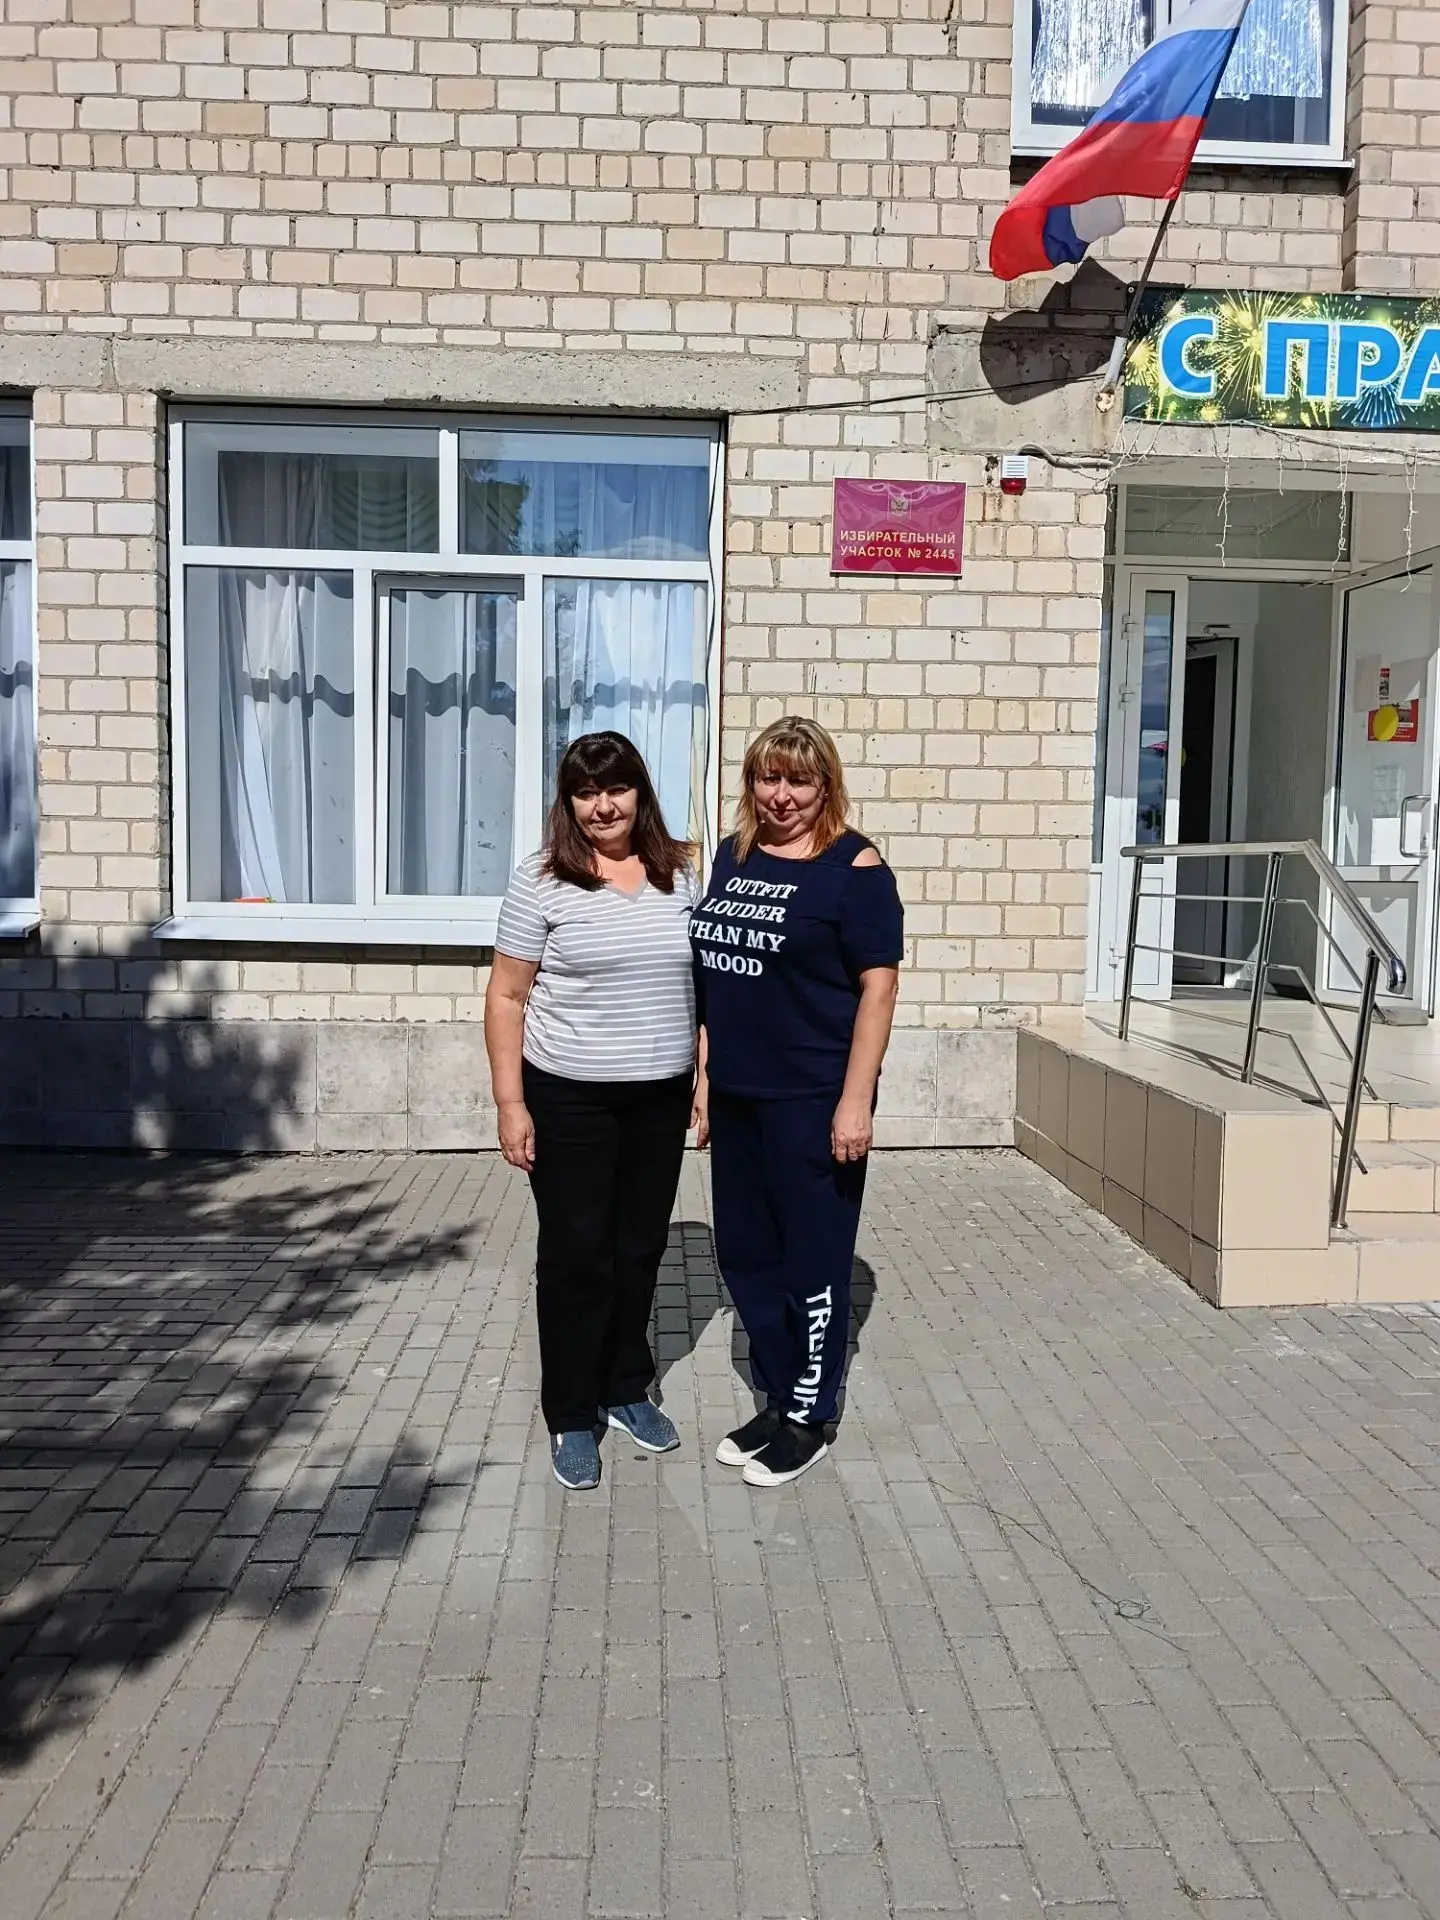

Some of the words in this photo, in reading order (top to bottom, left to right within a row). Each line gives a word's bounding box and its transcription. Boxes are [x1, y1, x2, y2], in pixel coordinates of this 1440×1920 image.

[1160, 315, 1216, 397] С
[1263, 319, 1440, 403] ПРА
[840, 530, 956, 544] ИЗБИРАТЕЛЬНЫЙ
[840, 545, 902, 558] УЧАСТОК
[907, 547, 921, 558] №
[925, 548, 955, 560] 2445
[725, 877, 798, 899] OUTFIT
[702, 898, 786, 923] LOUDER
[688, 919, 742, 945] THAN
[746, 928, 786, 952] MY
[700, 949, 763, 976] MOOD
